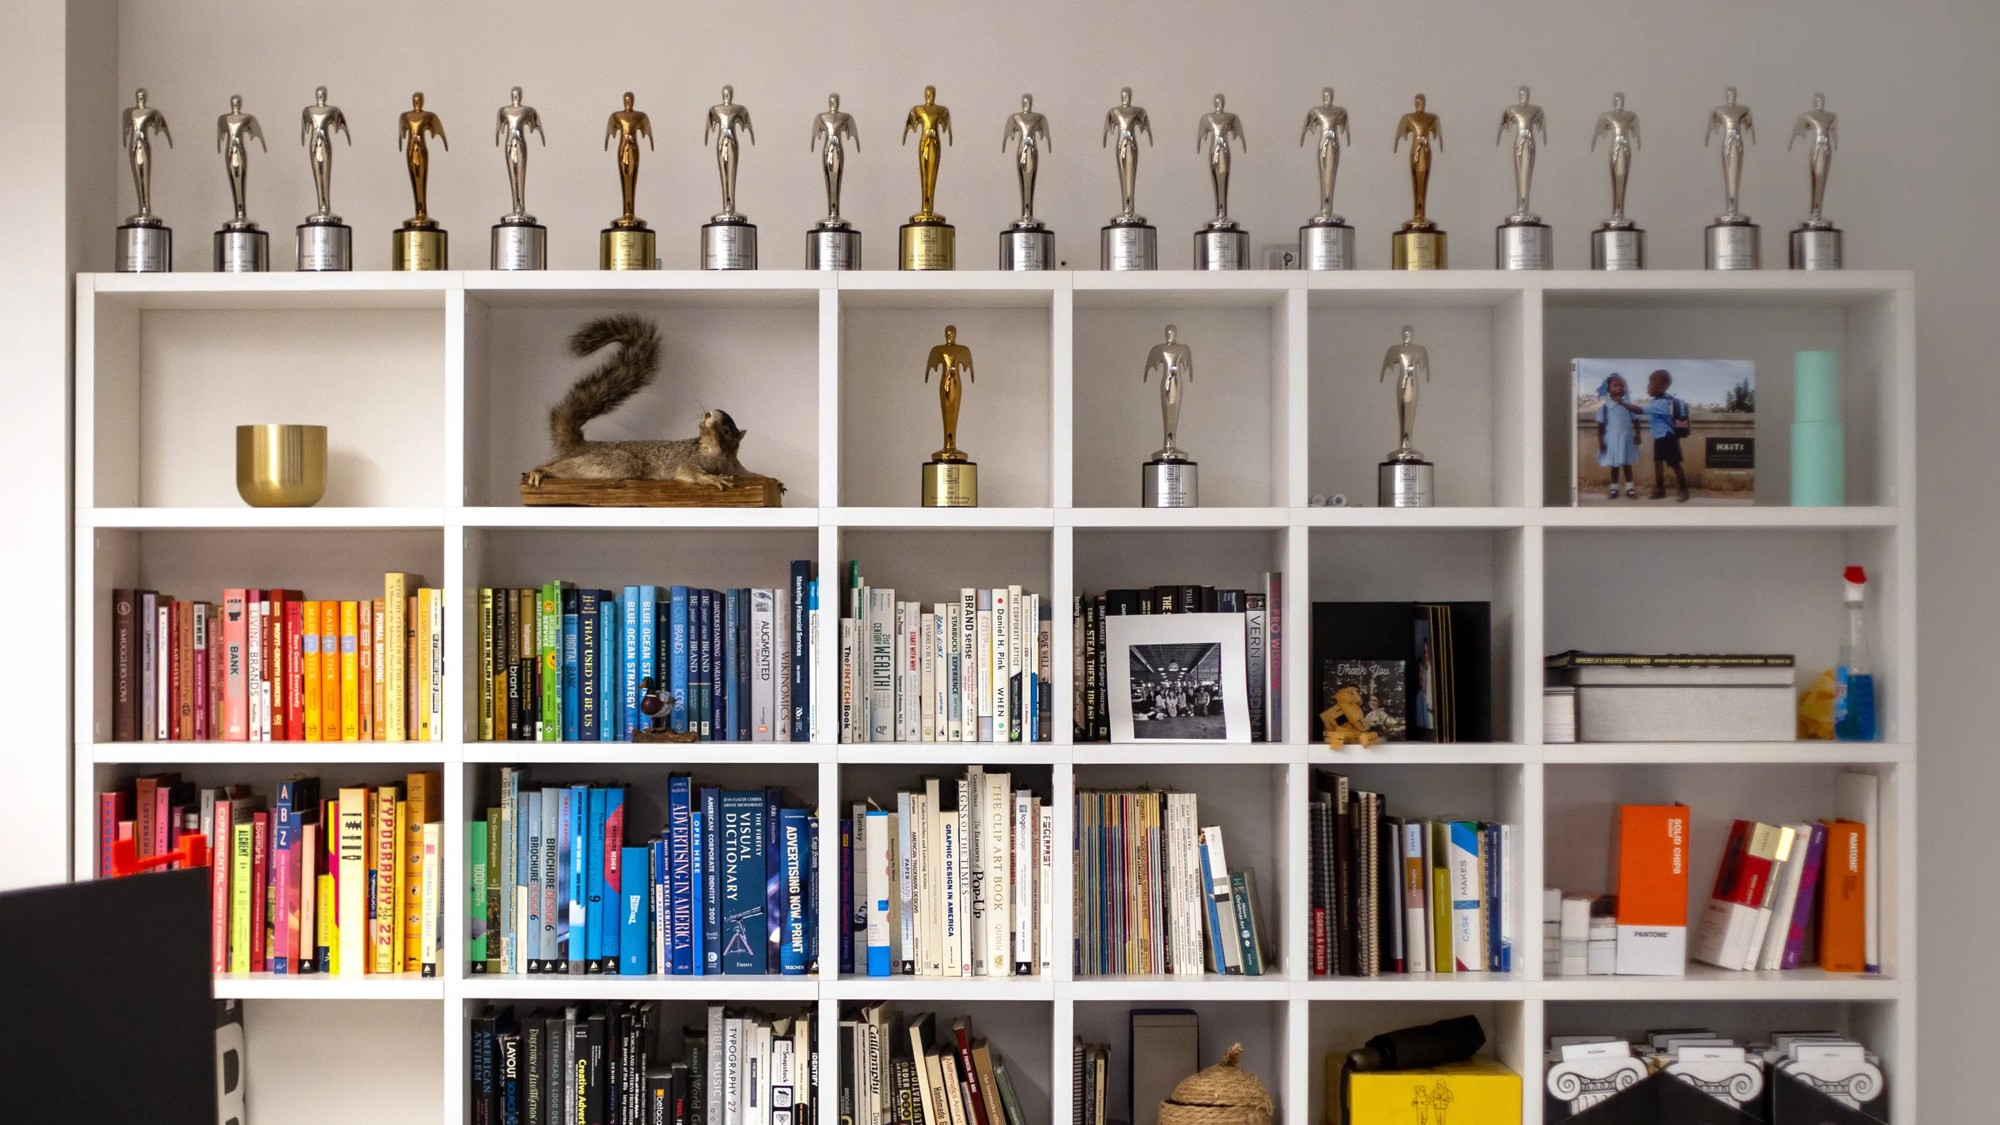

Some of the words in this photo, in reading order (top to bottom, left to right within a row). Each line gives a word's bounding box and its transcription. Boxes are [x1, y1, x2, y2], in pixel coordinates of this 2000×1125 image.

[627, 602, 635, 624] BLUE
[675, 604, 683, 622] HOW
[690, 596, 698, 606] BE
[702, 596, 709, 606] BE
[965, 596, 974, 630] BRAND
[250, 610, 258, 648] LIVING
[376, 612, 384, 641] PRIMAL
[675, 624, 683, 654] BRANDS
[1251, 616, 1260, 658] VERN
[567, 634, 576, 664] DIGITAL
[627, 629, 635, 658] OCEAN
[761, 620, 770, 680] AUGMENTED
[997, 640, 1004, 649] H.
[250, 652, 258, 696] BRANDS
[376, 643, 384, 683] BRANDING
[567, 666, 576, 688] BANK
[675, 656, 683, 687] BECOME
[874, 646, 890, 686] WEALTH
[1338, 664, 1367, 676] Thank
[1369, 664, 1390, 678] You
[119, 681, 128, 702] COVE
[510, 666, 518, 698] brand
[585, 680, 593, 694] TO
[627, 662, 635, 708] STRATEGY
[781, 651, 789, 720] WIKINOMICS
[1251, 663, 1260, 725] GOSDIN
[585, 698, 593, 711] BE
[675, 689, 683, 711] ICONS
[585, 714, 593, 726] US
[281, 785, 289, 799] A
[993, 785, 1002, 809] THE
[281, 808, 287, 822] B
[961, 822, 967, 832] OF
[993, 814, 1002, 841] CLIP
[217, 807, 225, 885] EXPERIMENTAL
[238, 830, 248, 856] ALCHEMY
[255, 822, 264, 864] lovemarks
[280, 831, 290, 846] Z
[380, 796, 393, 905] TYPOGRAPHY
[673, 804, 688, 878] ADVERTISING
[740, 813, 751, 861] VISUAL
[726, 814, 737, 900] DICTIONARY
[786, 826, 800, 893] ADVERTISING
[993, 848, 1002, 871] ART
[474, 863, 485, 884] 1000
[674, 883, 688, 894] IN
[961, 858, 969, 895] TIMES
[790, 896, 801, 920] NOW.
[946, 892, 953, 900] IN
[993, 876, 1002, 910] BOOK
[380, 924, 393, 945] 22
[675, 897, 690, 950] AMERICA
[792, 923, 803, 953] PRINT
[507, 1042, 515, 1078] LAYOUT
[528, 1029, 538, 1065] DIRECTORY
[728, 1028, 736, 1096] TYPOGRAPHY
[869, 1024, 880, 1094] Calligraphy
[578, 1060, 586, 1094] Creative
[946, 1058, 960, 1099] Mathematics
[953, 1100, 963, 1124] Around
[507, 1082, 515, 1112] SOURCE
[528, 1074, 538, 1119] ILLUSTRATION
[691, 1079, 701, 1109] World
[728, 1101, 736, 1113] 27
[933, 1087, 945, 1119] Handmade
